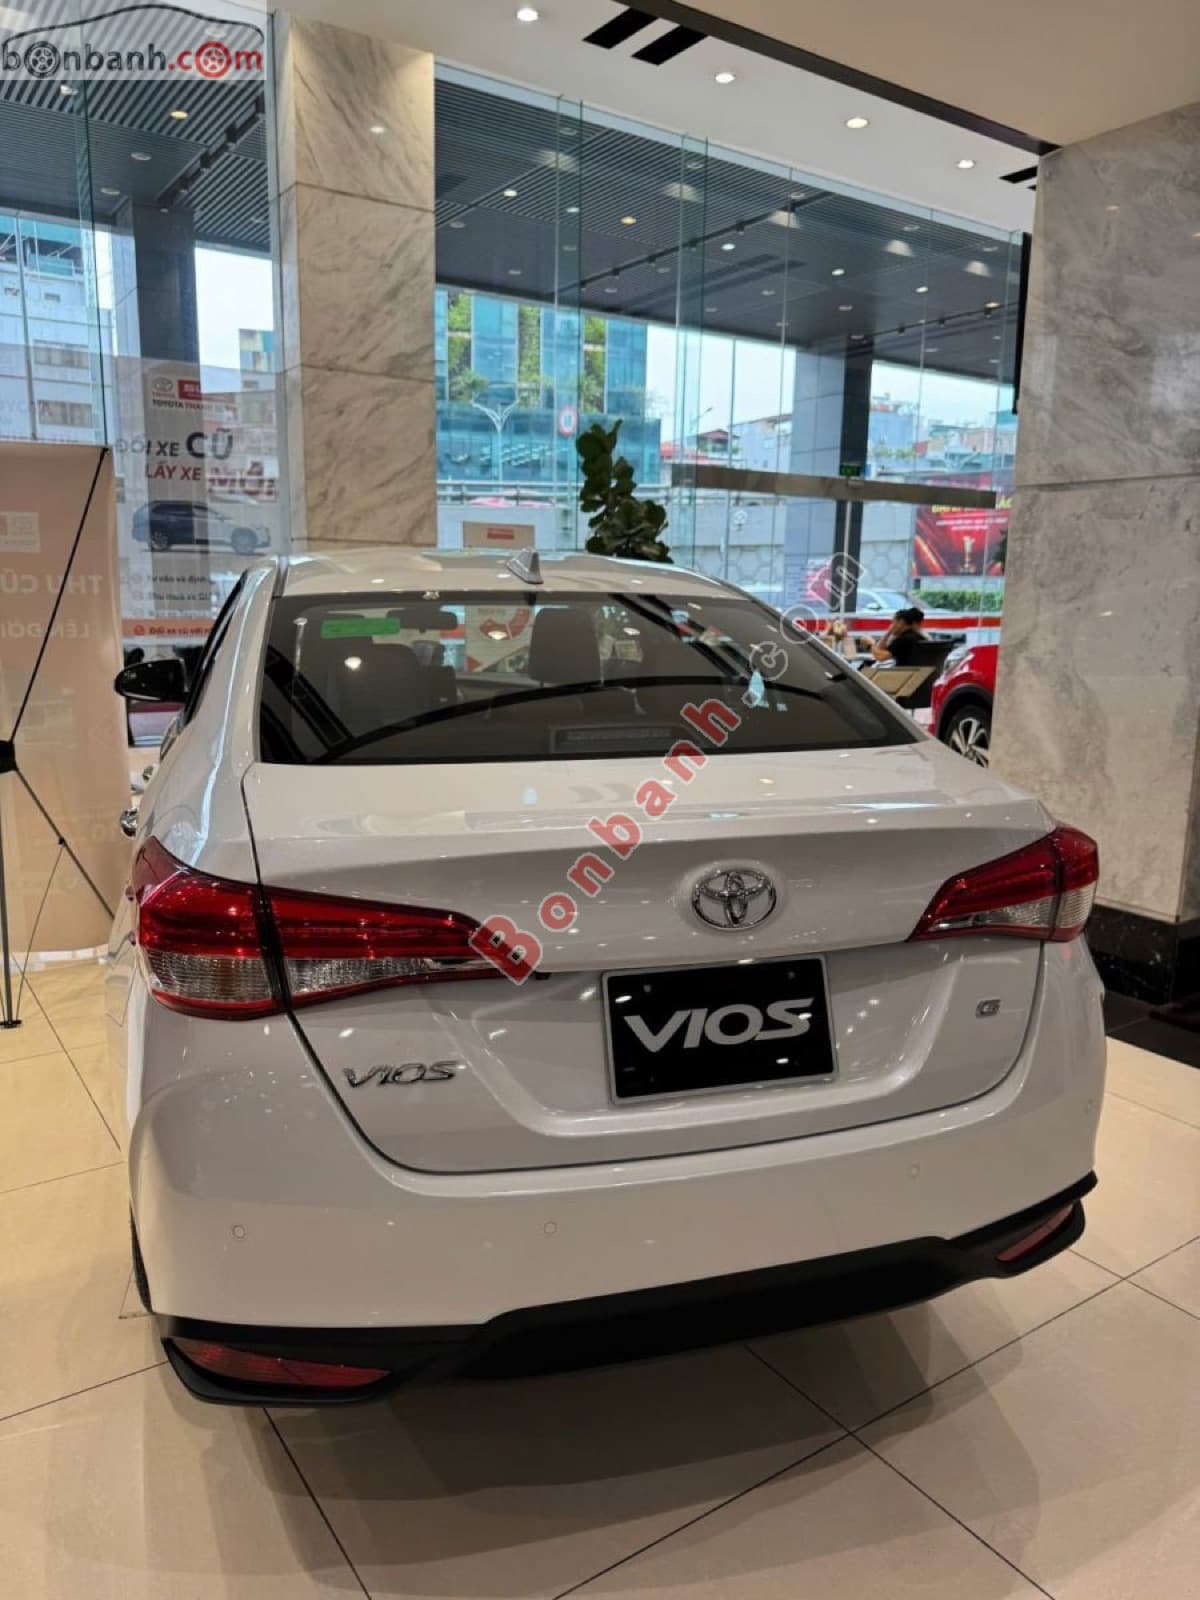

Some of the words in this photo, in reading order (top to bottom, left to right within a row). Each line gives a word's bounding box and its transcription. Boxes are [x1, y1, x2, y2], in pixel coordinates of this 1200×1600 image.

[156, 441, 179, 457] XE
[186, 428, 233, 460] CŨ
[146, 459, 176, 480] LẤY
[180, 466, 201, 481] XE
[623, 997, 815, 1052] VIOS
[343, 1060, 458, 1088] VIOS
